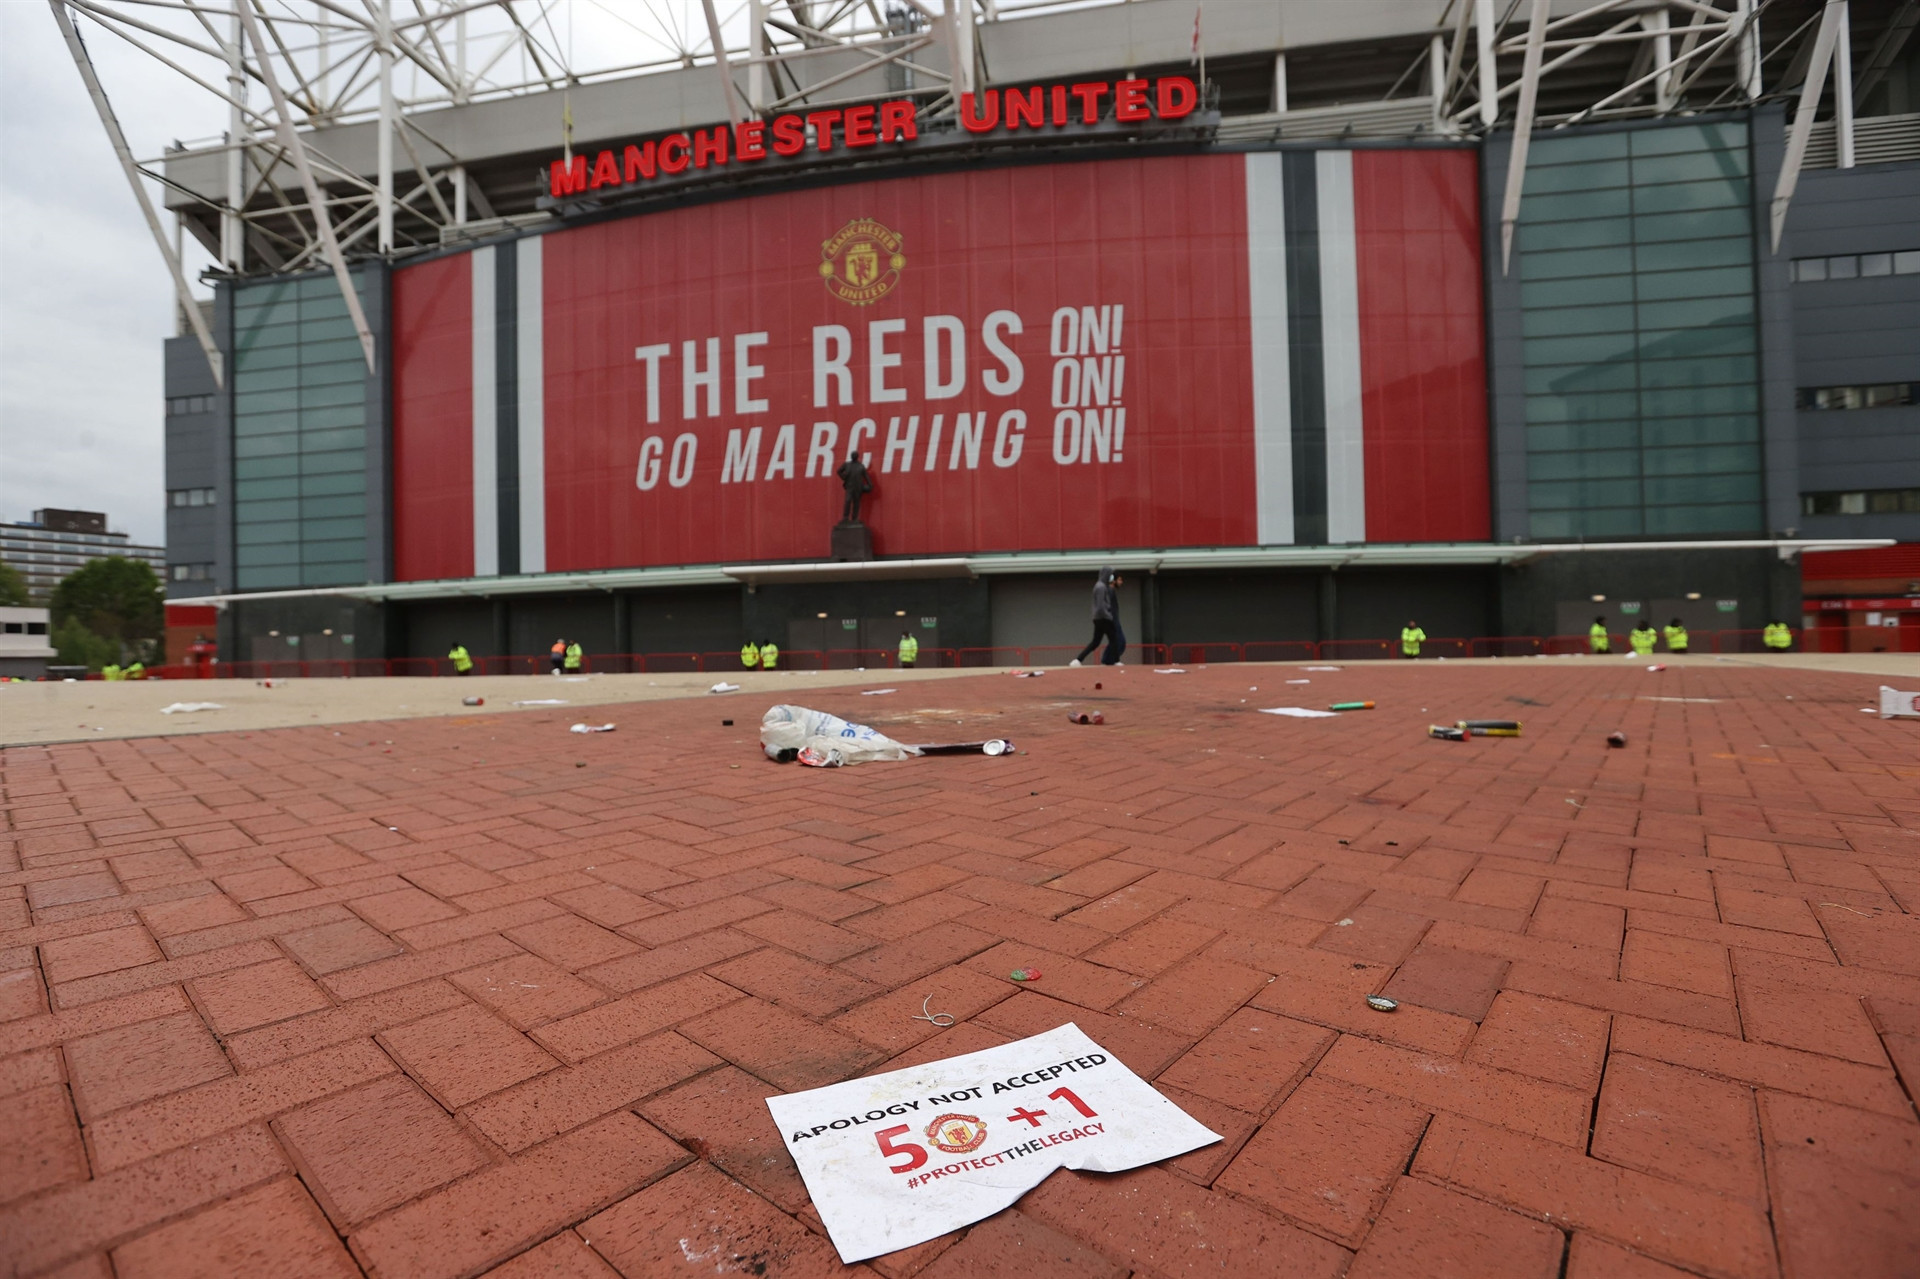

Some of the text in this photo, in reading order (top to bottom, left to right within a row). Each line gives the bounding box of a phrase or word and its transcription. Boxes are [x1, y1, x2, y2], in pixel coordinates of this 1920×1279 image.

[550, 76, 1198, 197] MANCHESTER UNITED
[827, 224, 897, 255] MANCHESTER
[838, 282, 888, 300] UNITED
[1050, 304, 1124, 357] ON!
[635, 309, 1024, 423] THE REDS
[1051, 355, 1125, 408] ON!
[636, 407, 1126, 490] GO MARCHING ON!
[792, 1054, 1107, 1143] APOLOGY NOT ACCEPTED
[906, 1121, 1106, 1190] #PROTECTTHELEGACY
